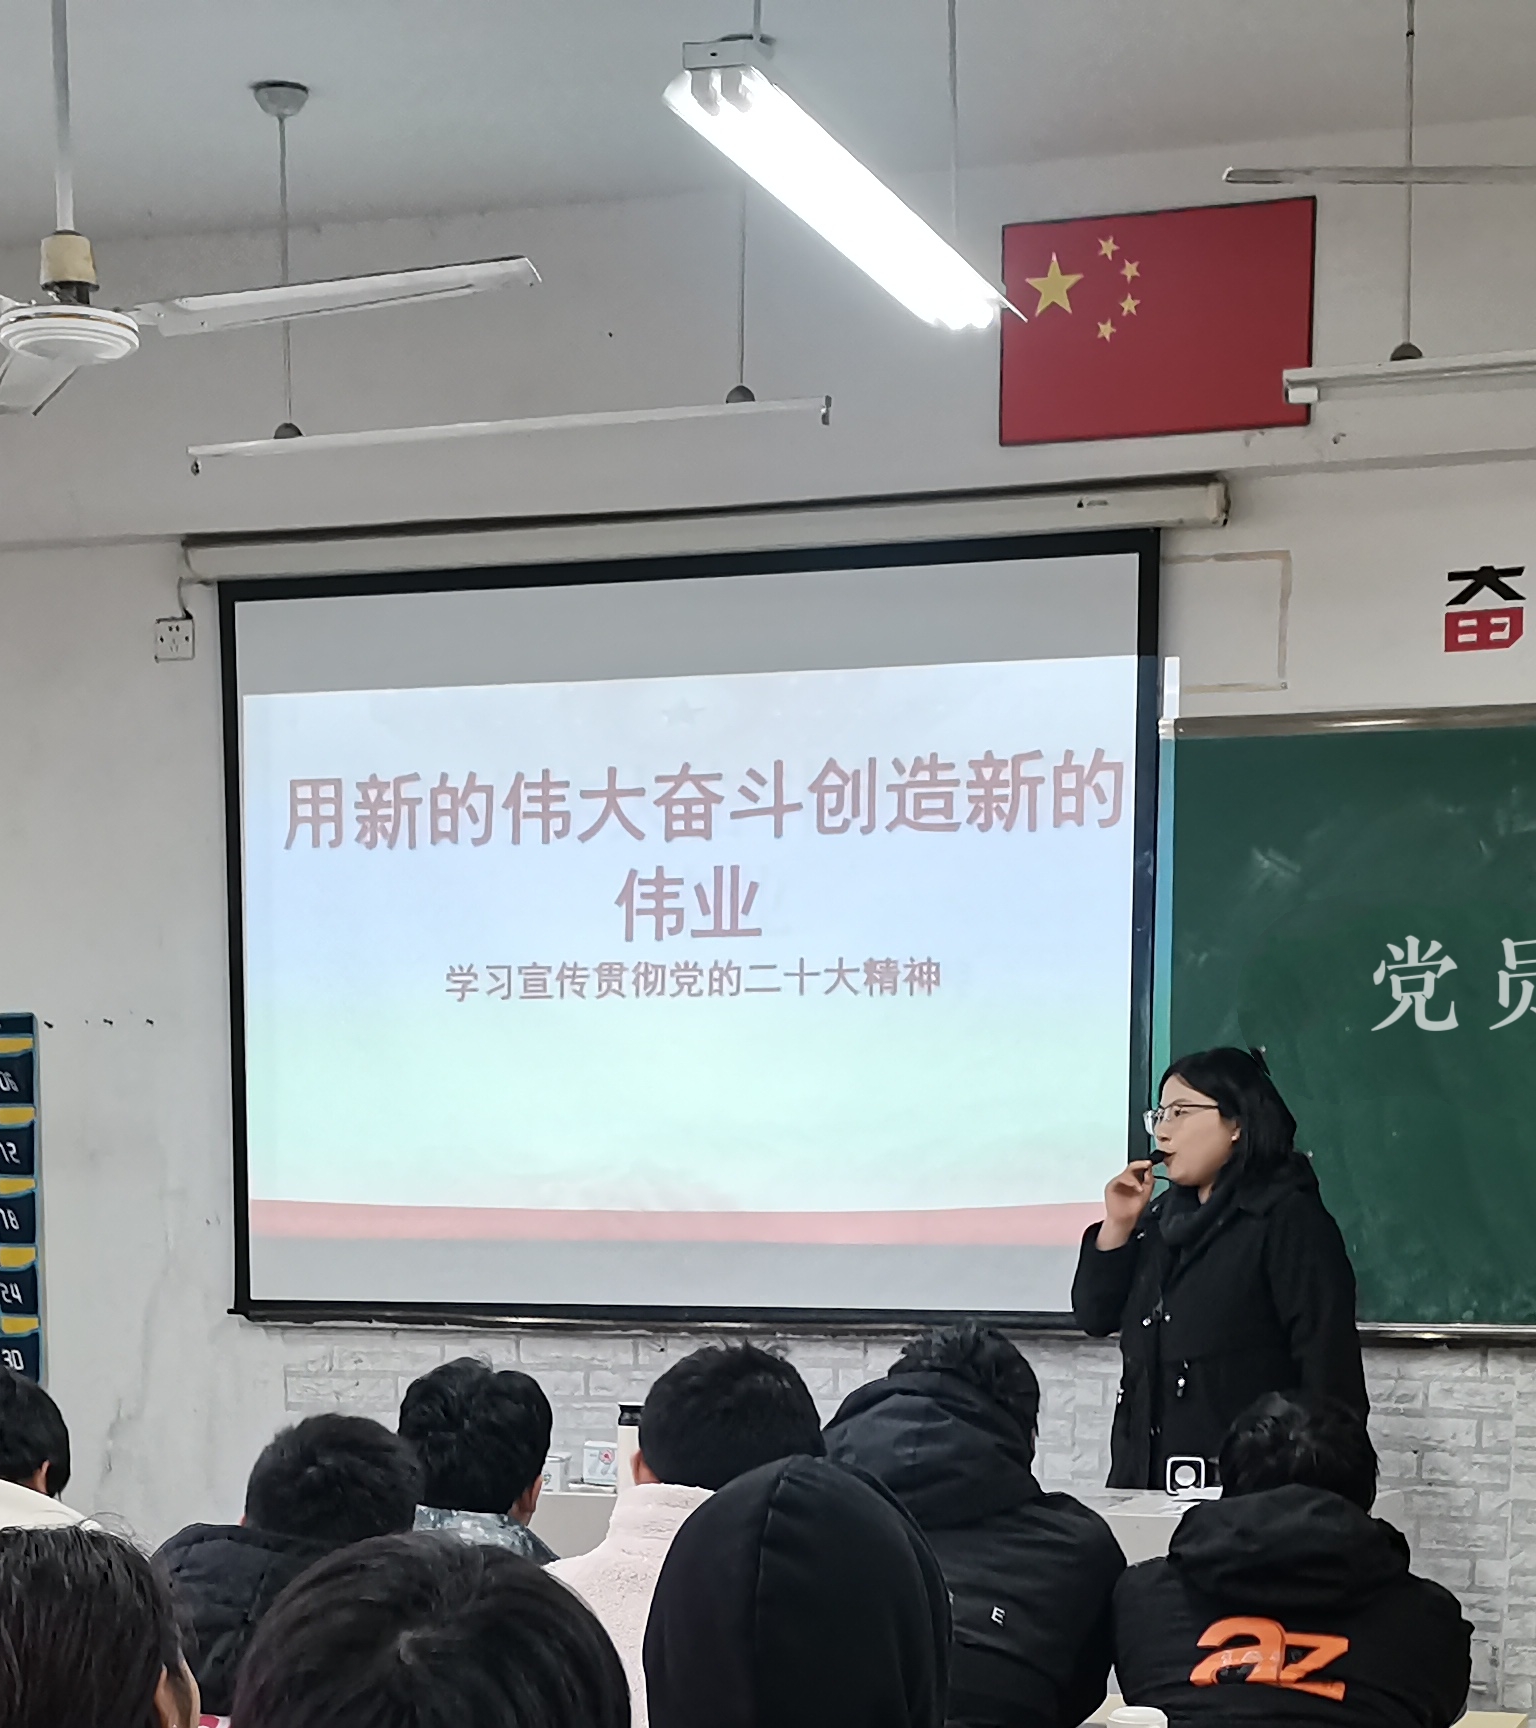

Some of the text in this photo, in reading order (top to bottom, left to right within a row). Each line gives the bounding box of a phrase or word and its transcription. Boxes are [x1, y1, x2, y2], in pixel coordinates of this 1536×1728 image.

[284, 747, 1126, 851] 用新的伟大奋斗创造新的
[614, 865, 764, 942] 伟业
[443, 955, 943, 1003] 学习宣传贯彻党的二十大精神
[1, 1348, 25, 1371] 30
